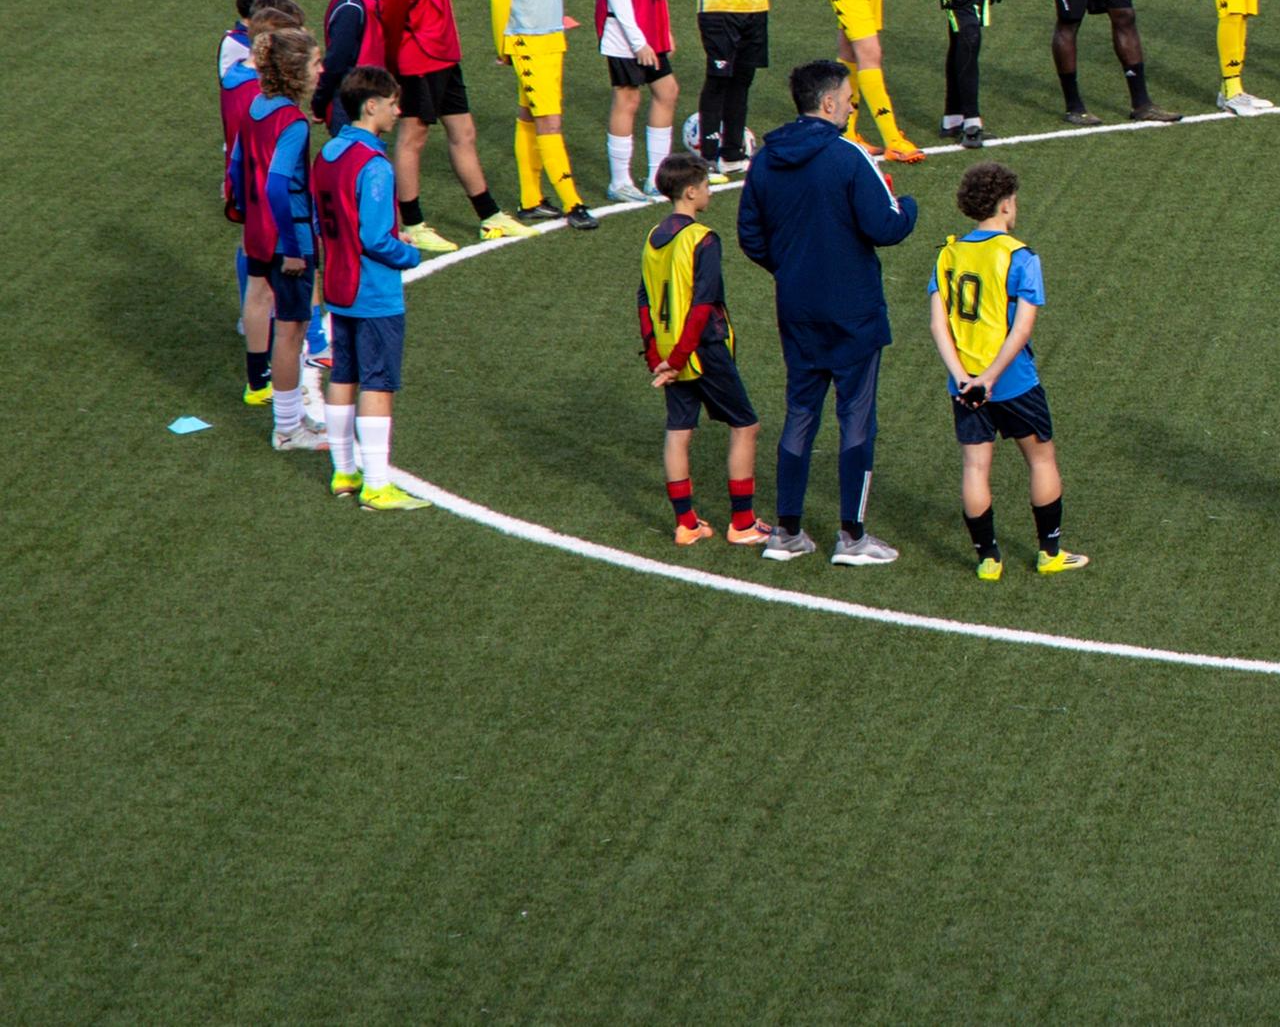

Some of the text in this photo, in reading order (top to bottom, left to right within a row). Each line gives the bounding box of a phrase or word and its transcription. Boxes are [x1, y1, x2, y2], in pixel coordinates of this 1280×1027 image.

[320, 190, 339, 239] 5
[659, 279, 671, 333] 4
[945, 270, 982, 323] 10
